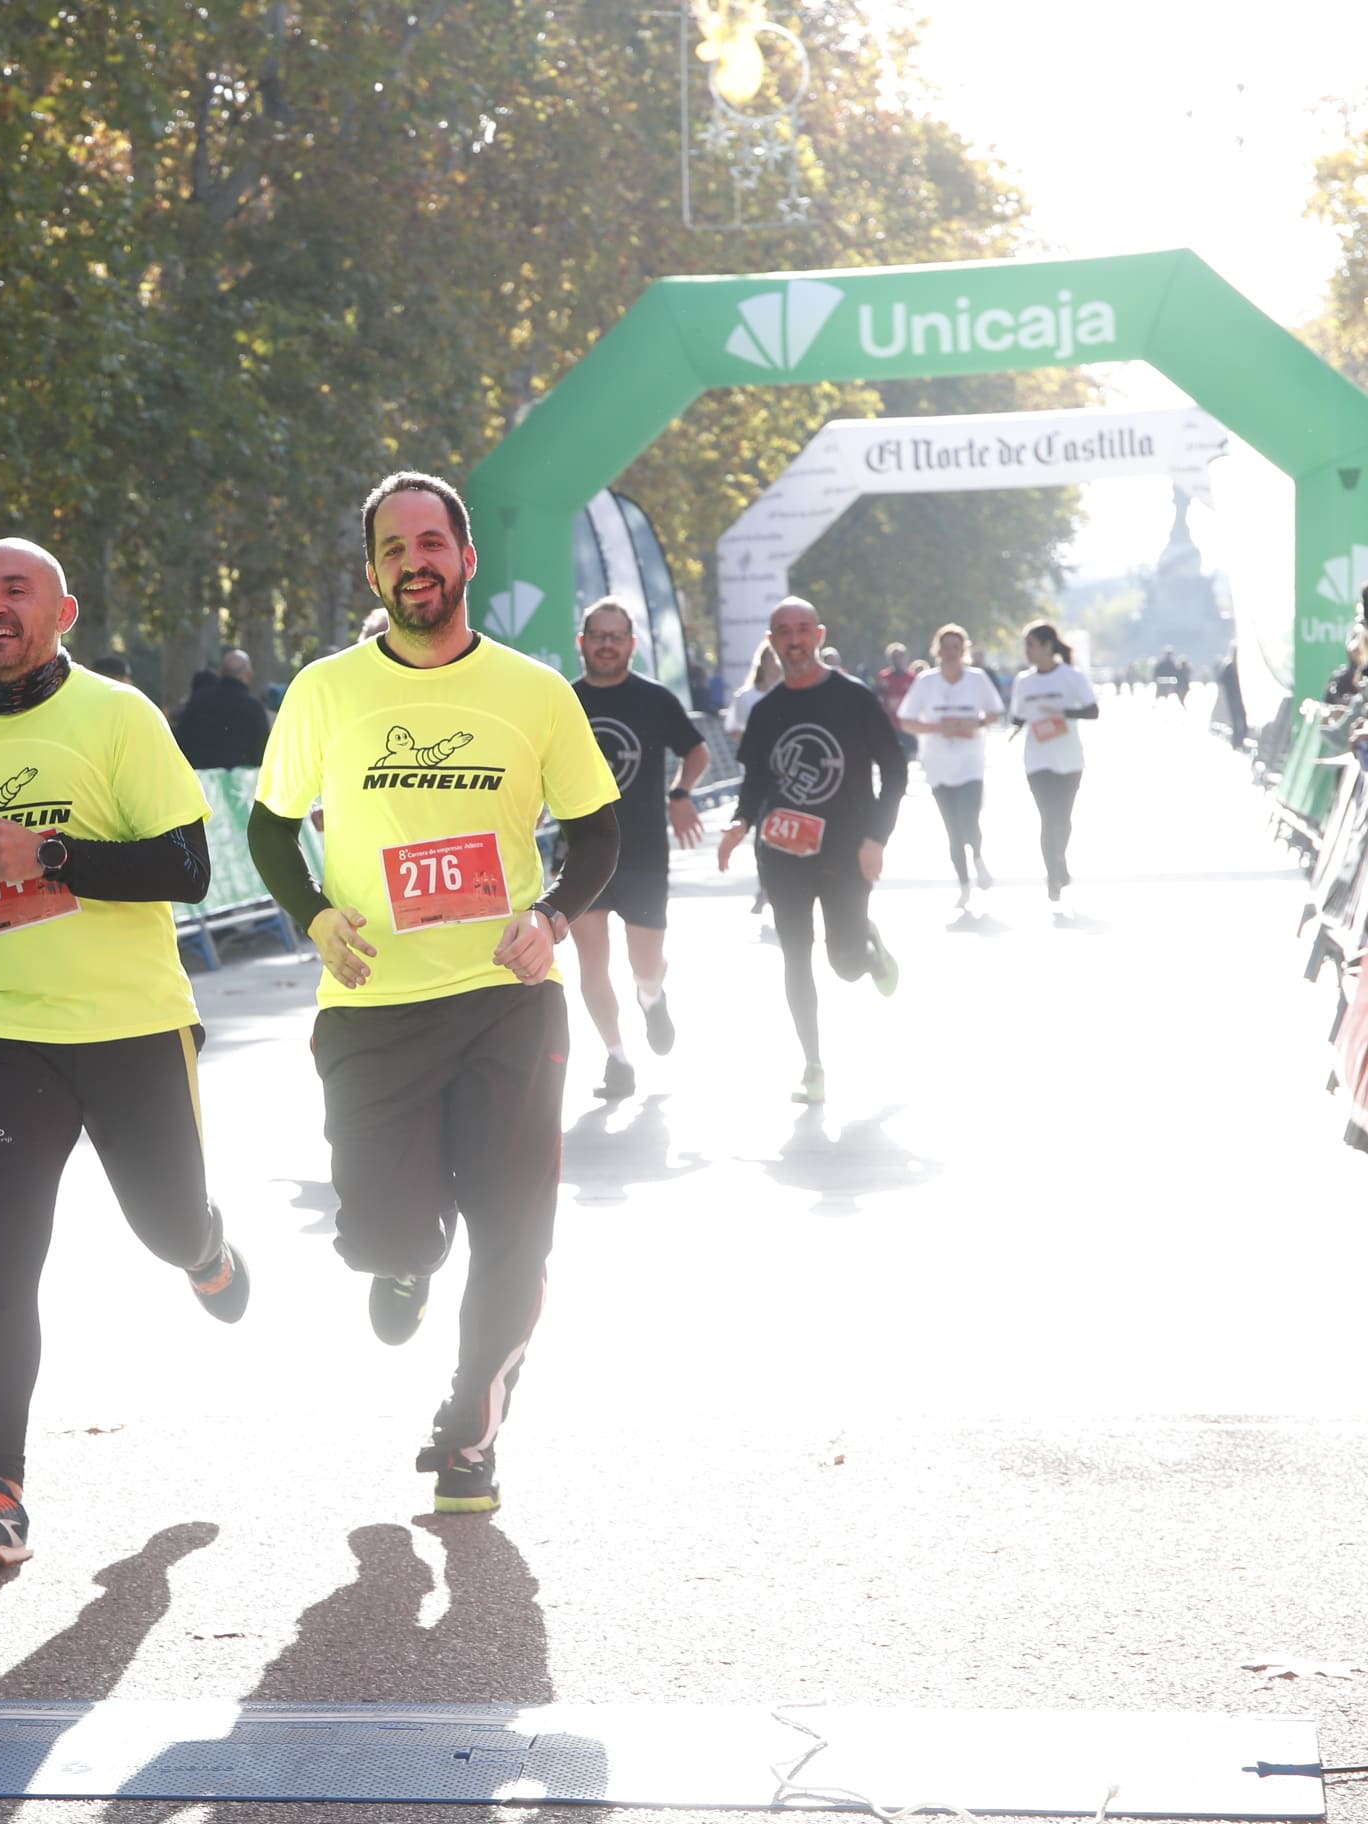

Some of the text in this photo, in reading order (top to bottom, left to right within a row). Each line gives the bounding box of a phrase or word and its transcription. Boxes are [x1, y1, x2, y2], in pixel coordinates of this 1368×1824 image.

[858, 289, 1117, 360] Unicaja
[865, 428, 1154, 473] El Norte de Castilla
[363, 773, 503, 791] MICHELIN
[399, 854, 463, 898] 276
